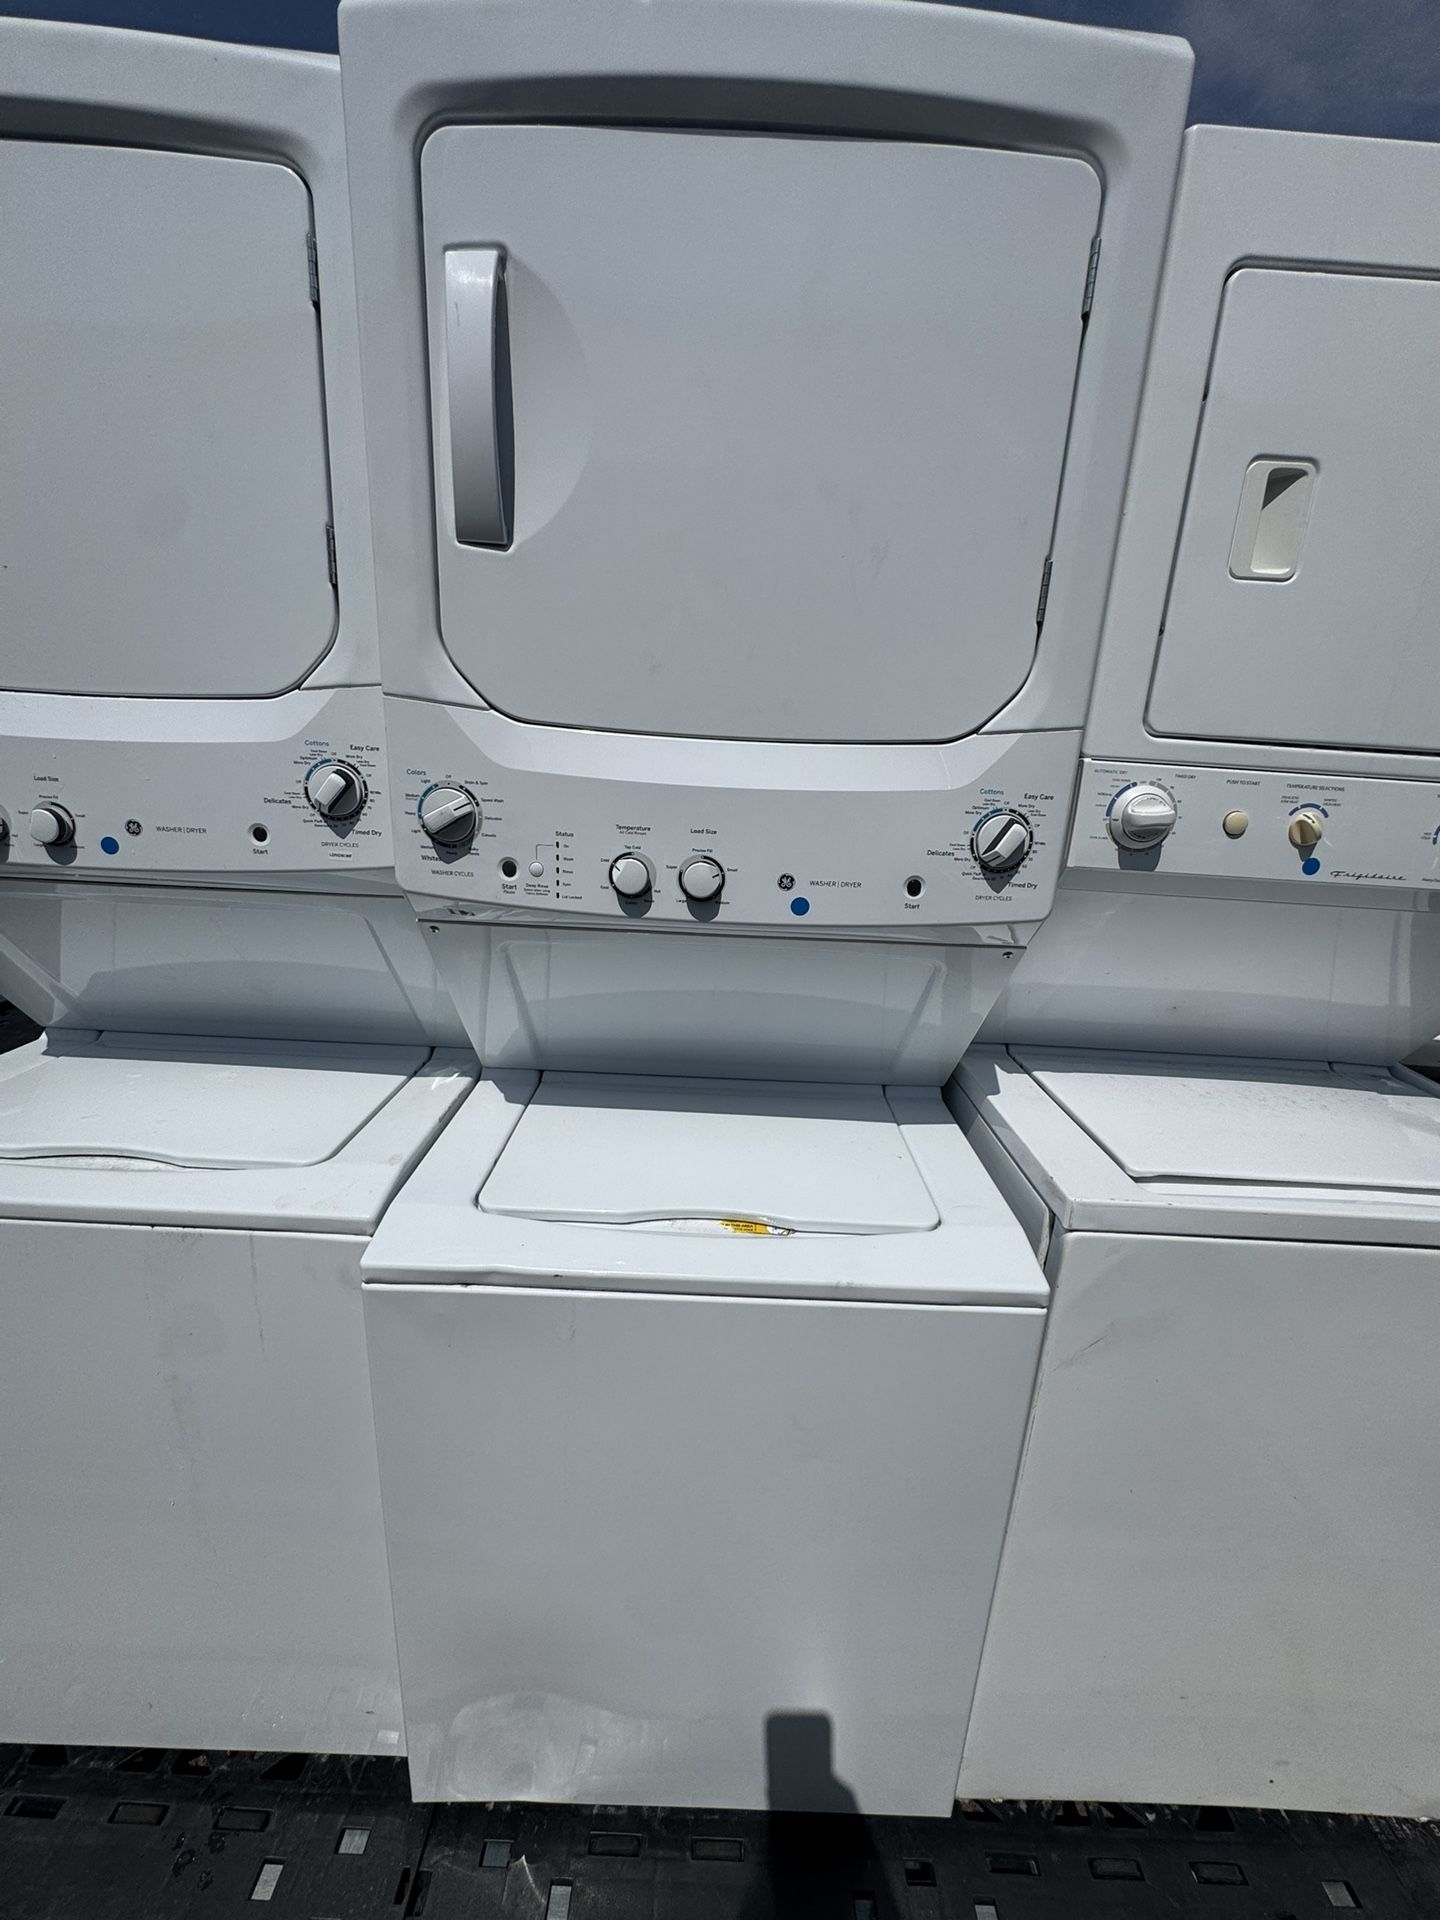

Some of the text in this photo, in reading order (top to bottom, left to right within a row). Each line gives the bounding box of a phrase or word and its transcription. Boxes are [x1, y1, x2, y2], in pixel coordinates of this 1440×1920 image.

[350, 744, 364, 752] Easy
[264, 797, 291, 805] Delicates
[1024, 793, 1038, 801] Easy
[616, 824, 651, 832] Temperature
[927, 849, 955, 857] Delicates
[1330, 870, 1406, 880] Frigidaire
[840, 881, 862, 889] DRYER
[1008, 881, 1038, 890] Timed Dry
